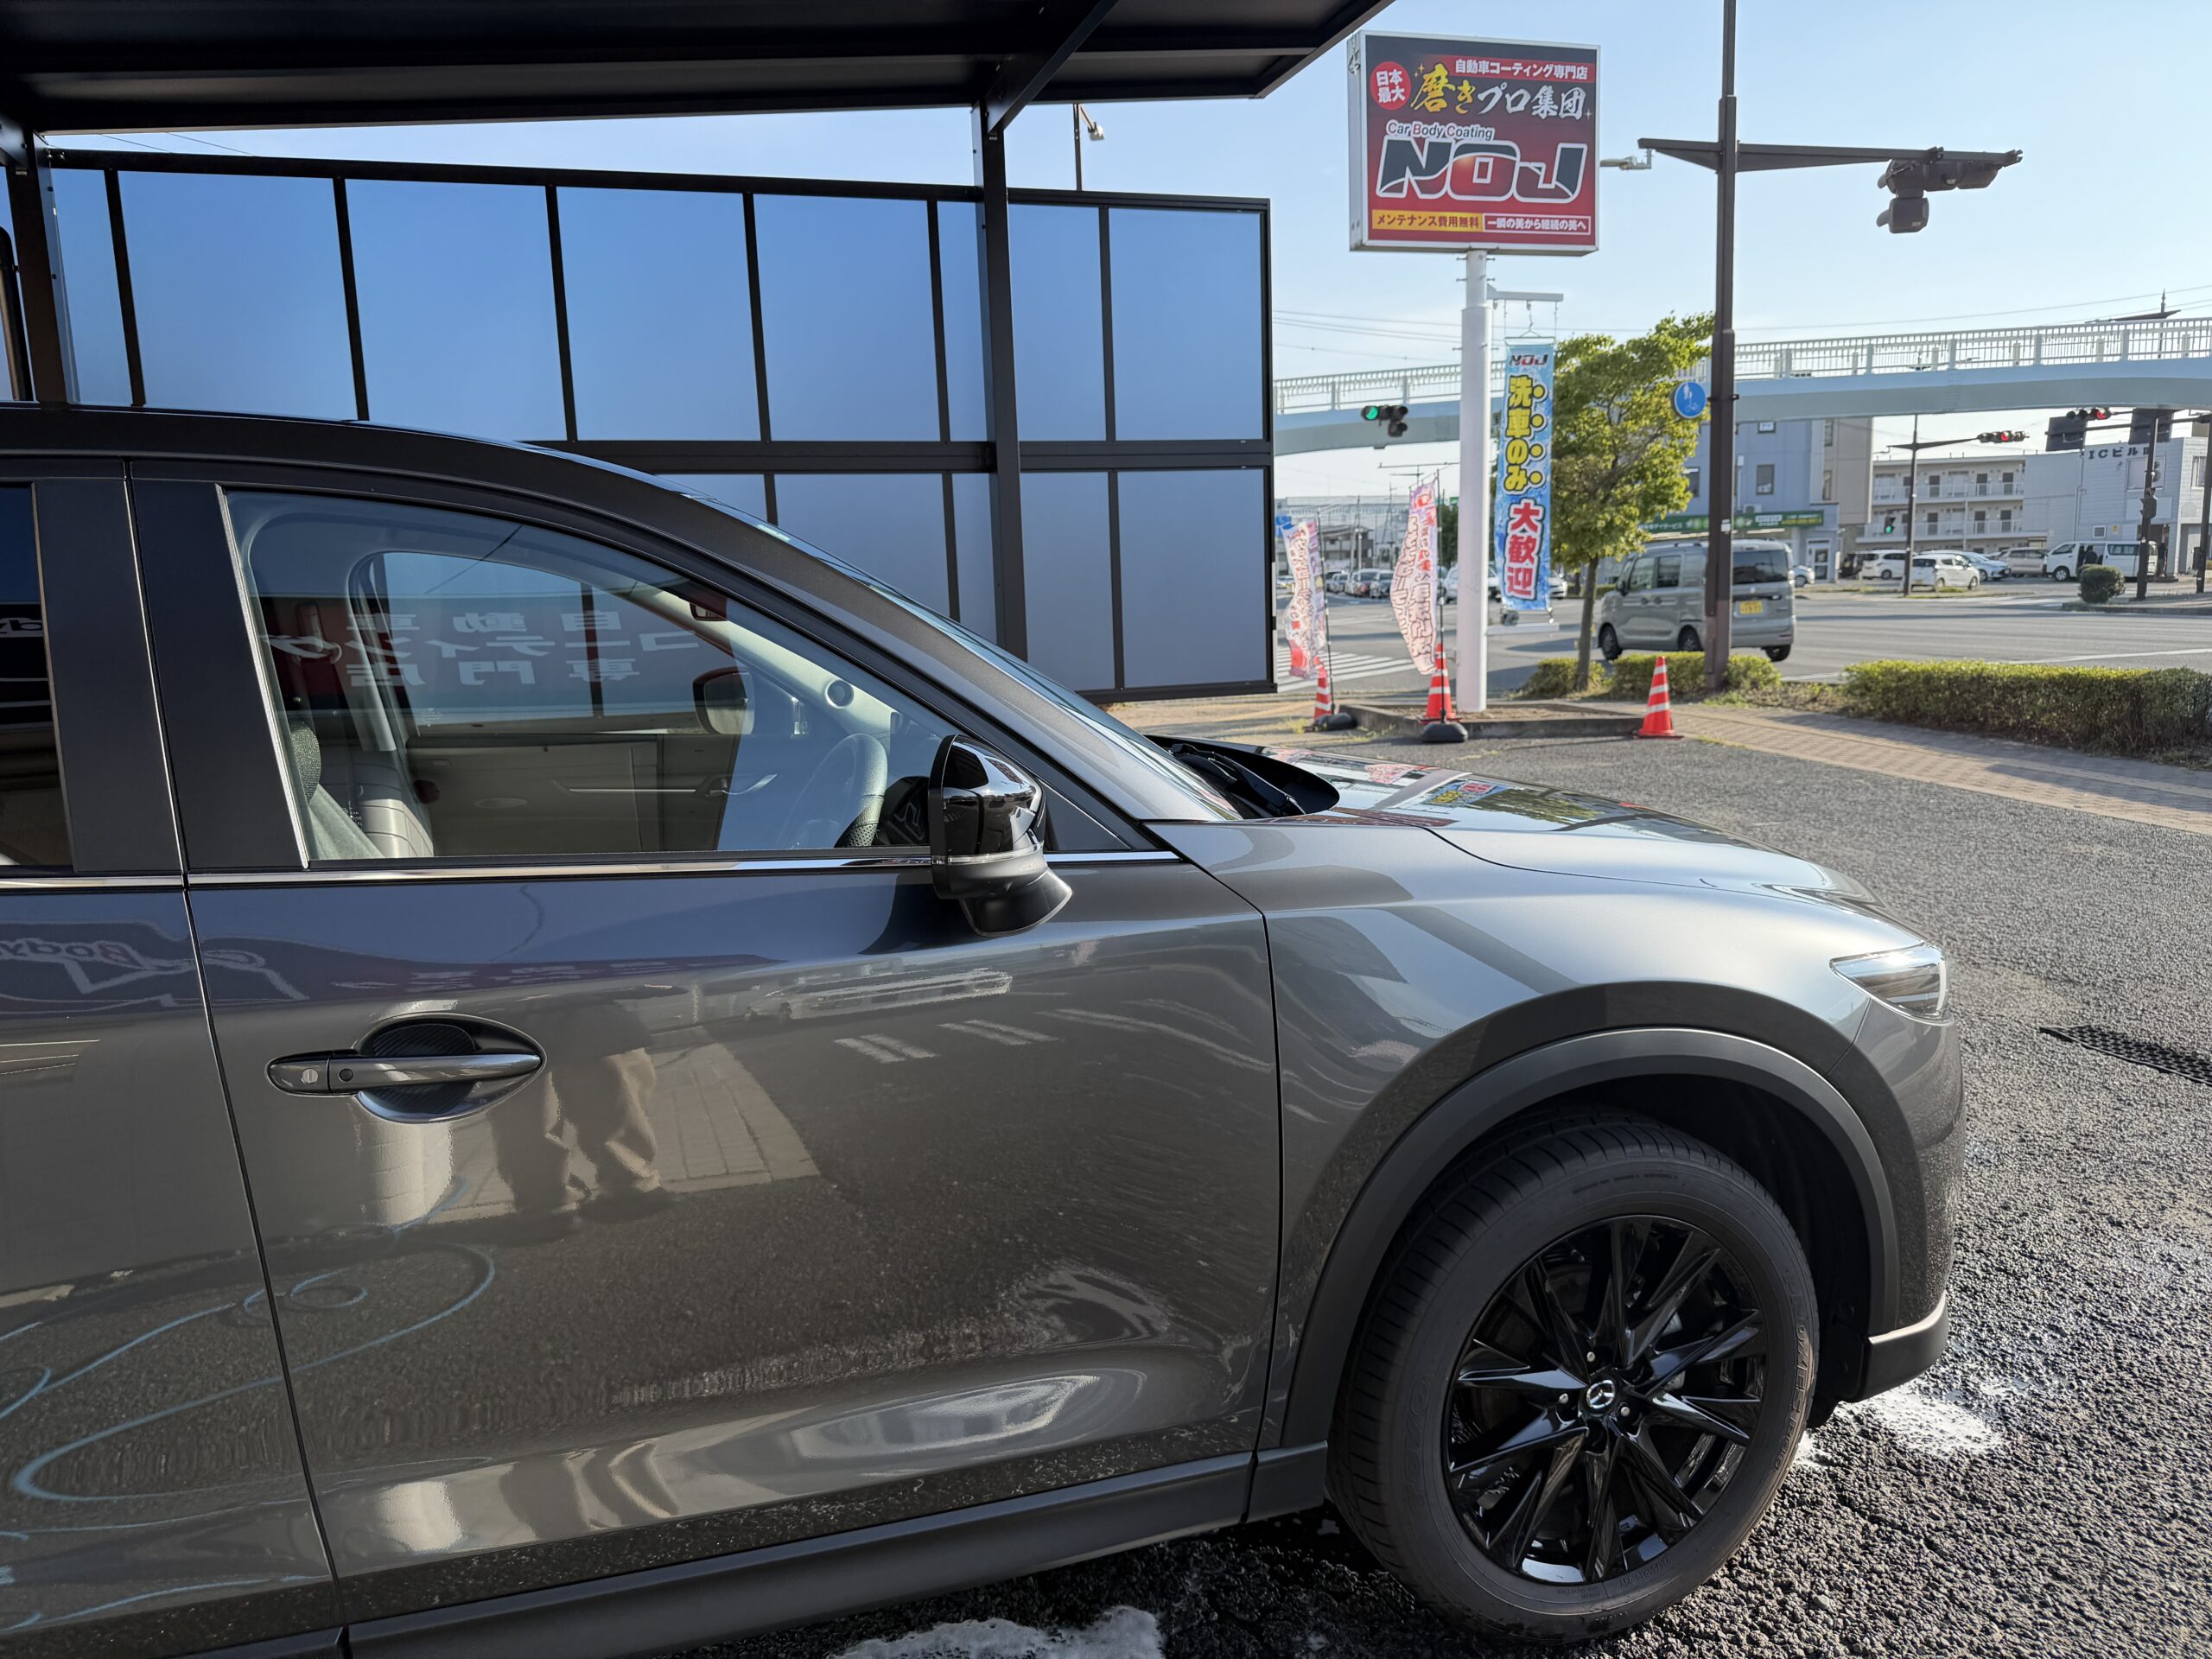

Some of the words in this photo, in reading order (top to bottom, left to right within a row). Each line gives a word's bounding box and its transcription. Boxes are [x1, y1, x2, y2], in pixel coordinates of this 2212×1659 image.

[1376, 69, 1403, 86] 日本
[1455, 59, 1588, 80] 自動車コーティング専門店
[1378, 86, 1407, 103] 最大
[1410, 62, 1587, 120] 磨きプロ集団
[1387, 121, 1410, 136] Car
[1412, 122, 1444, 138] Body
[1446, 124, 1494, 141] Coating
[1376, 135, 1588, 204] NOJ
[1376, 213, 1479, 229] メンテナンス費用無料
[1509, 353, 1548, 366] NOJ
[1504, 374, 1533, 492] 洗車のみ
[1506, 501, 1541, 596] 大歓迎
